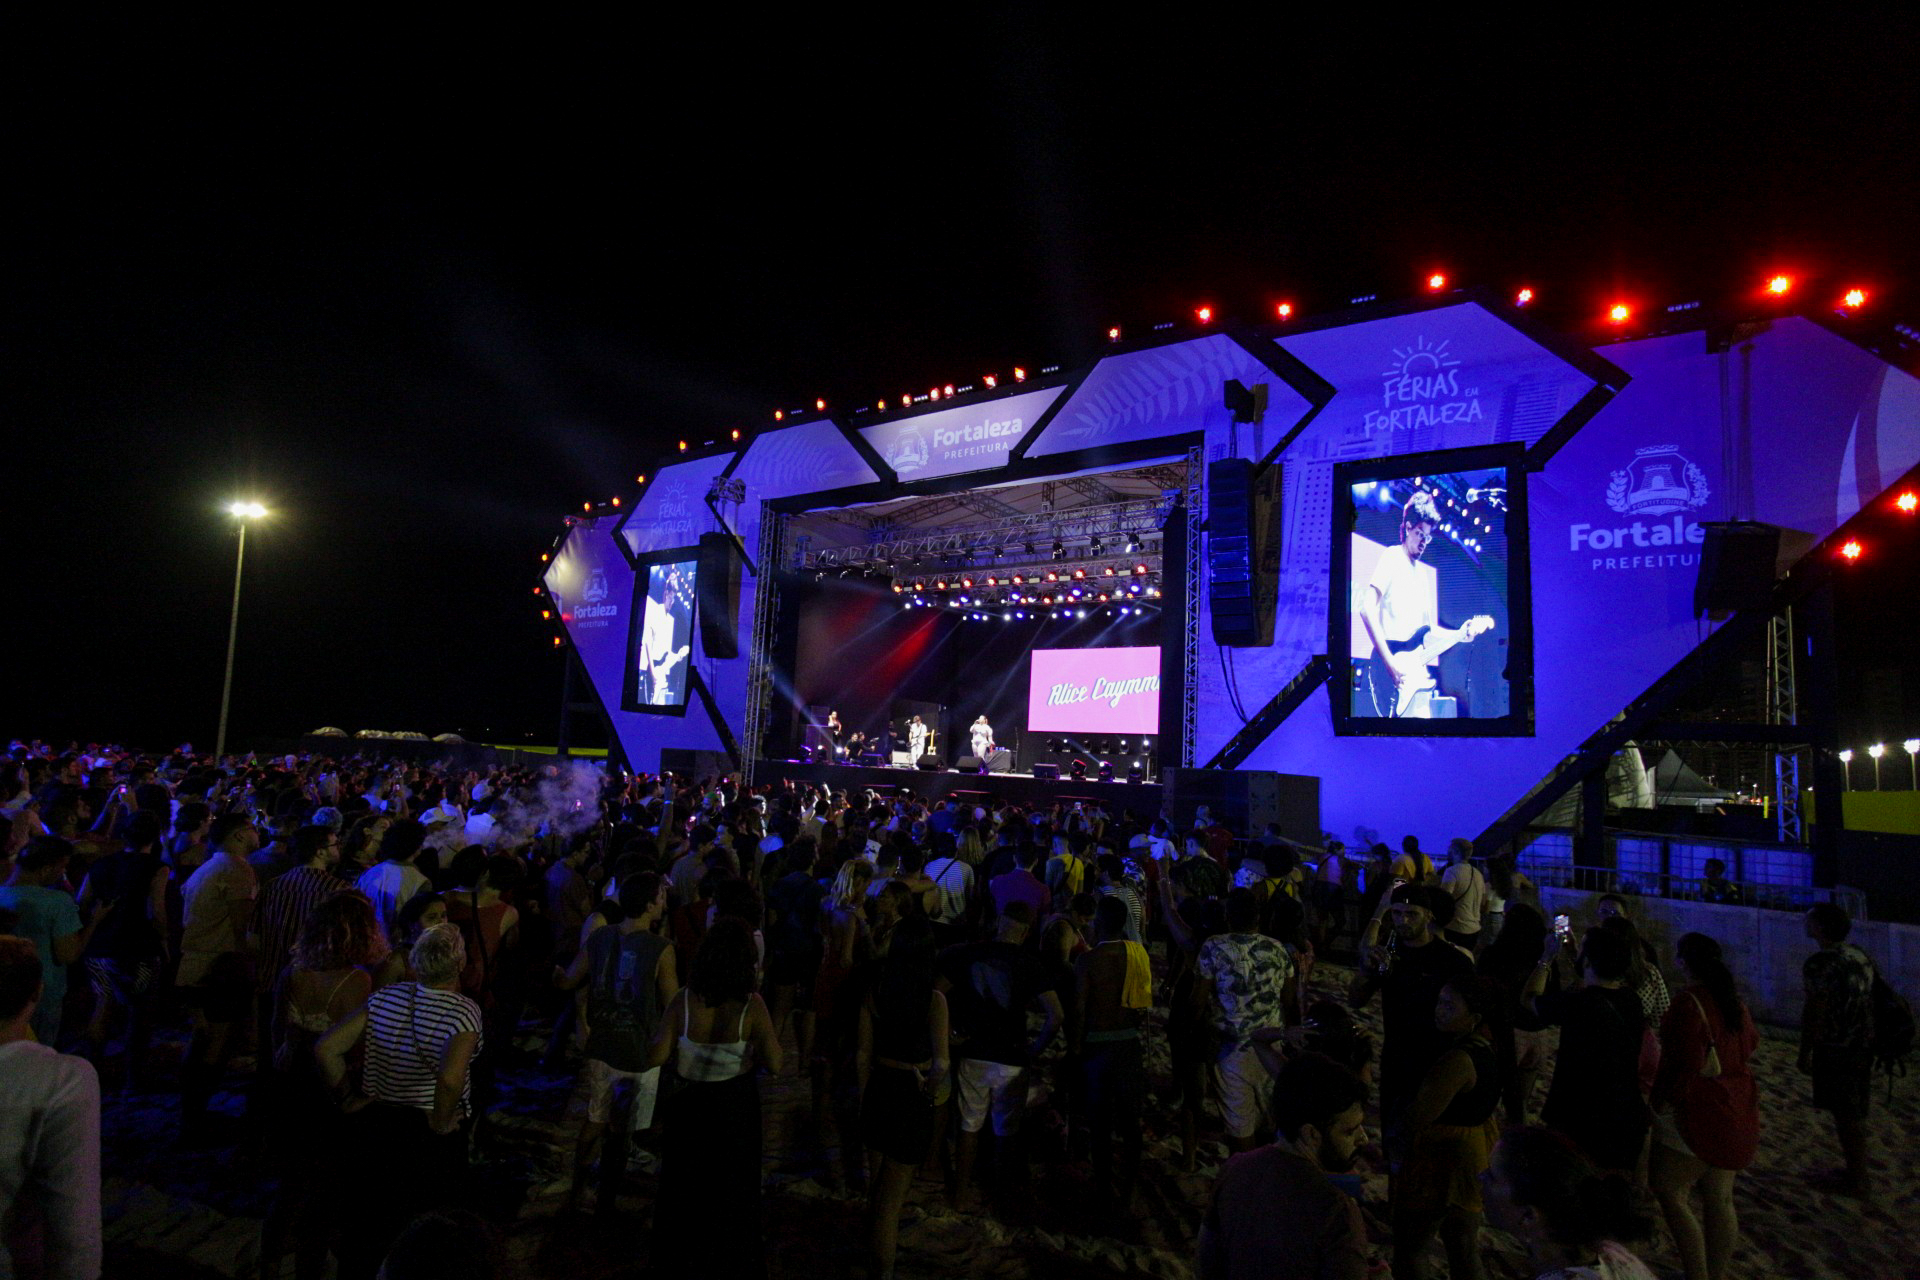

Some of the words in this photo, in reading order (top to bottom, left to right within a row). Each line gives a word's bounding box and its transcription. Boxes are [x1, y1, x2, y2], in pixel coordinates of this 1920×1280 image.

[1364, 399, 1483, 439] FORTALEZA
[933, 418, 1023, 448] Fortaleza
[944, 441, 1009, 460] PREFEITURA
[1570, 515, 1706, 551] Fortale
[1593, 553, 1702, 571] PREFEITU
[574, 602, 618, 619] Fortaleza
[1047, 682, 1089, 707] Alice
